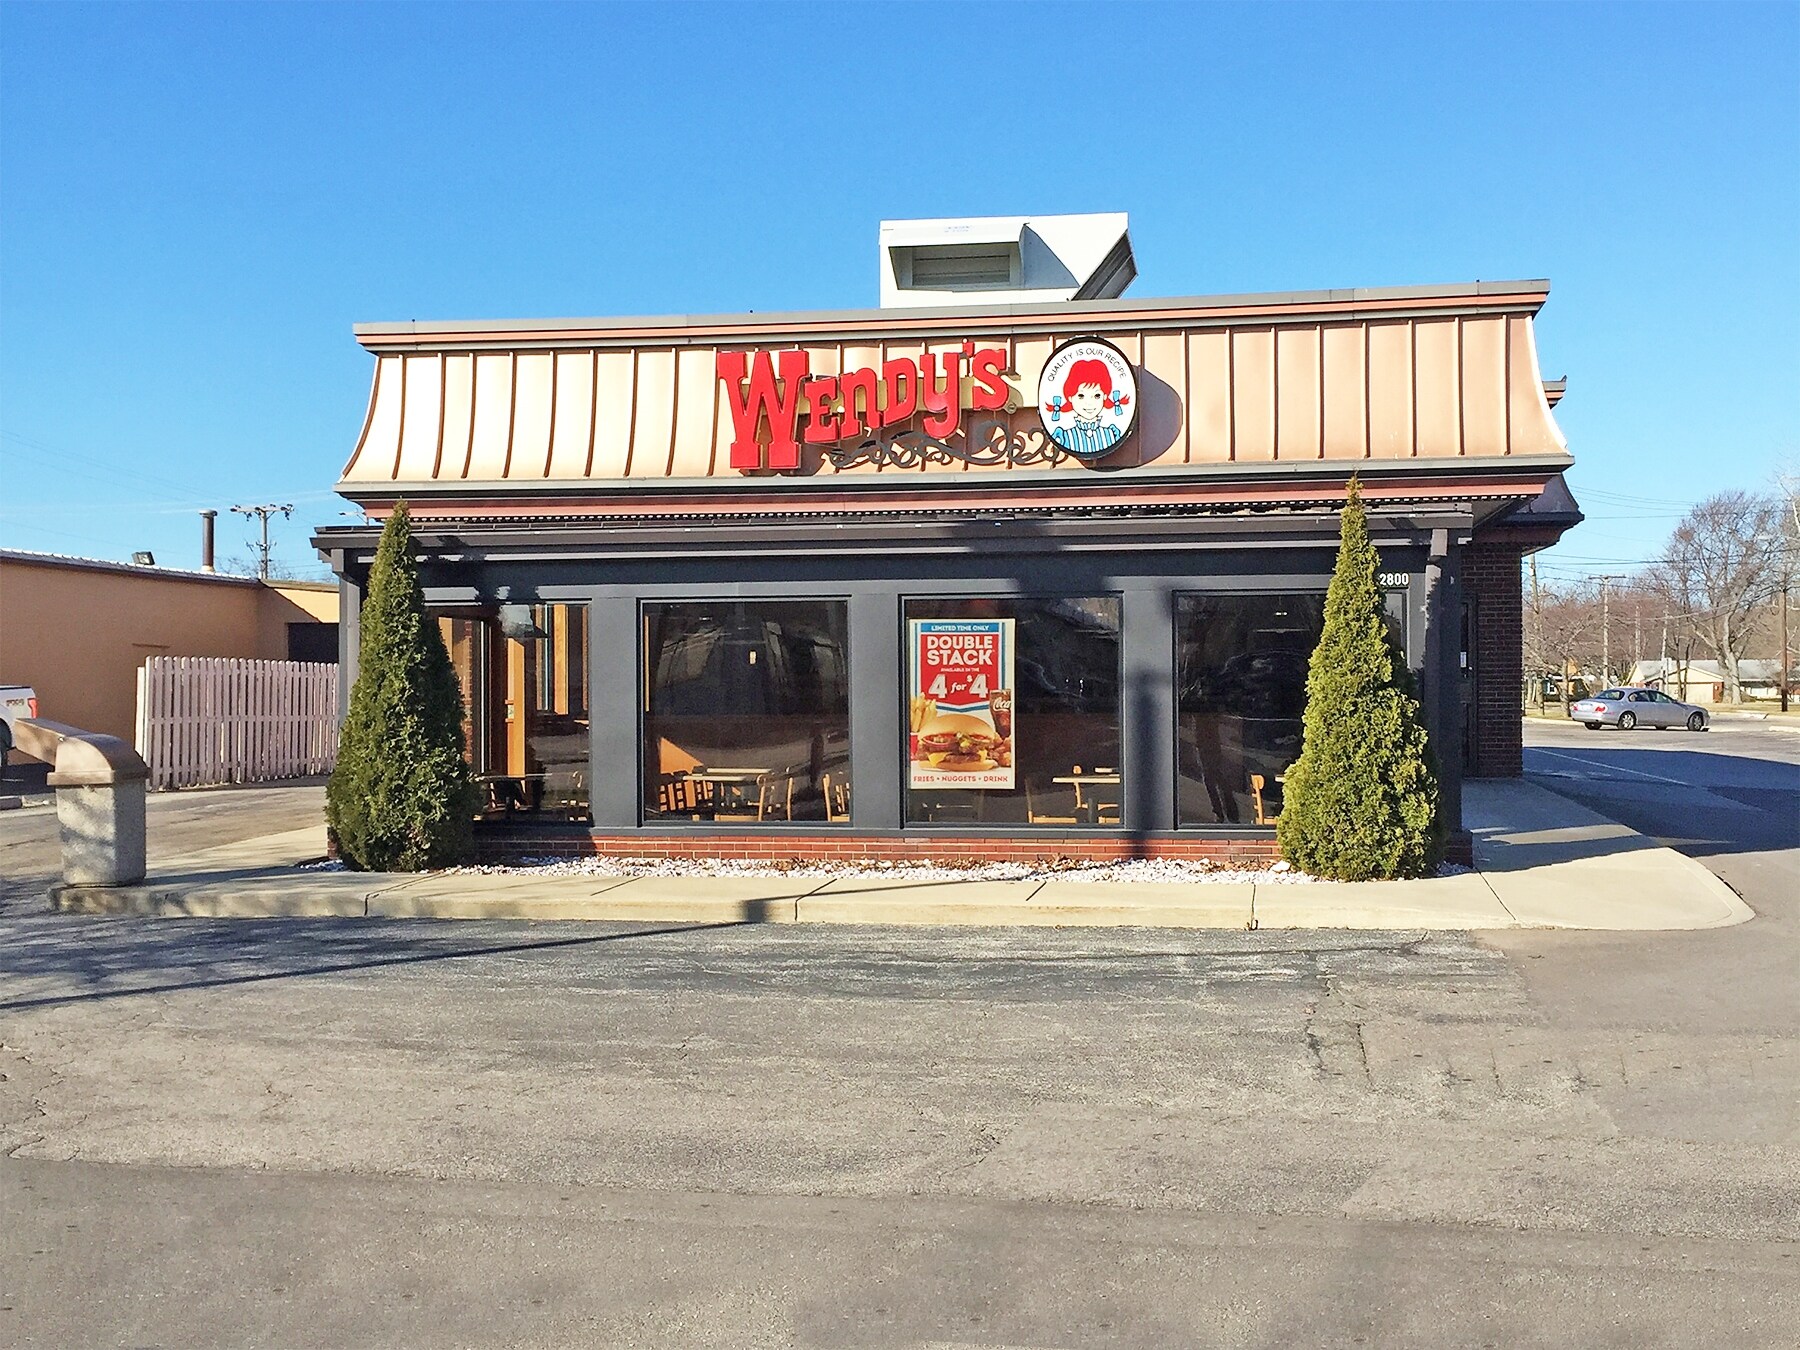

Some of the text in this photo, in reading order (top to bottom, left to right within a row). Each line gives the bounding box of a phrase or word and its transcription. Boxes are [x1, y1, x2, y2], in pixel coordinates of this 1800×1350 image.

[1048, 347, 1126, 381] QUALITY IS OUR RECIPE
[716, 338, 1011, 470] Wendy's
[1380, 573, 1409, 585] 2800
[927, 635, 993, 649] DOUBLE
[927, 649, 993, 665] STACK
[928, 673, 988, 699] 4 for $4
